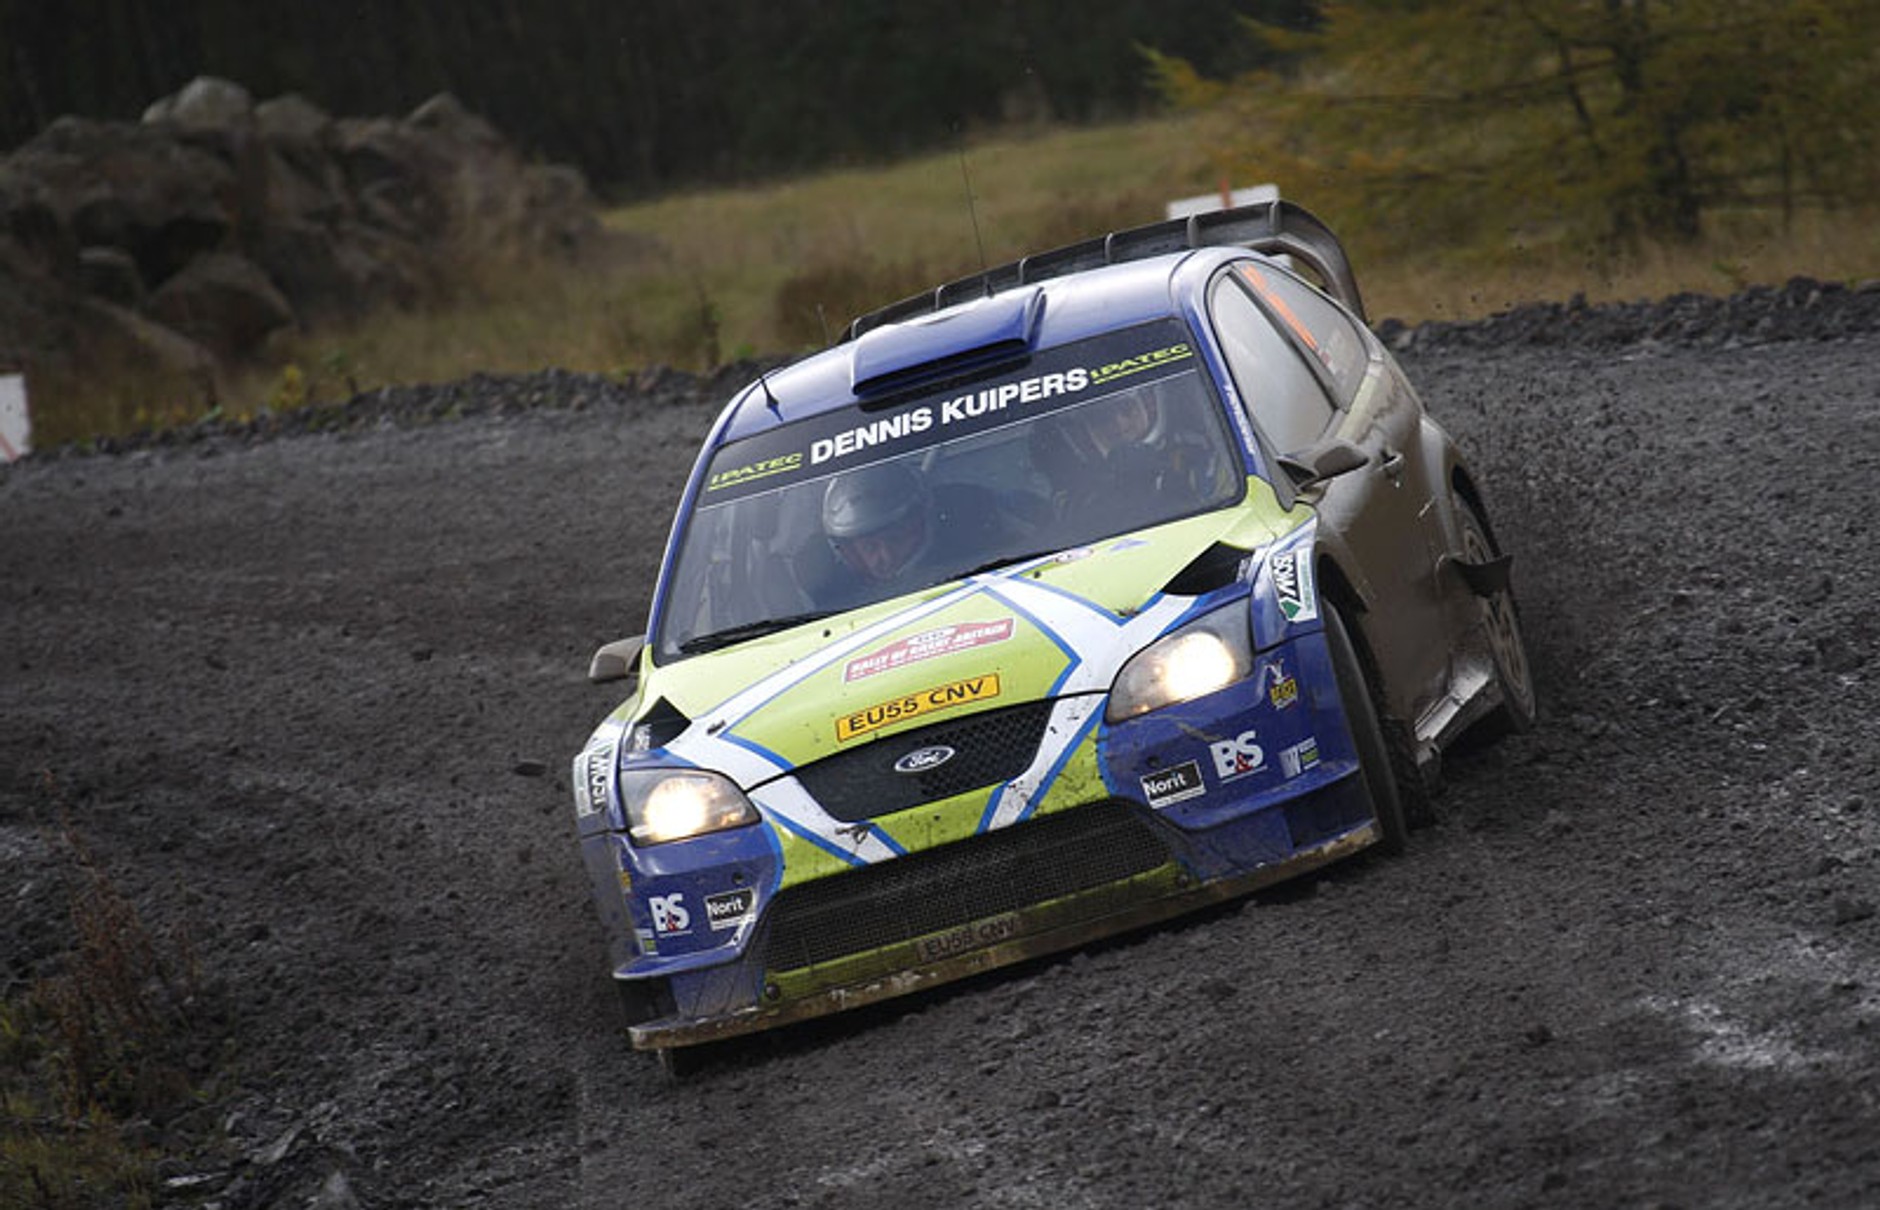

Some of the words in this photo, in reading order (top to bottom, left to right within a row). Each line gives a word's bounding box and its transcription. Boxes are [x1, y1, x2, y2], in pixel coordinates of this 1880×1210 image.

[810, 400, 933, 465] DENNIS
[940, 367, 1090, 426] KUIPERS
[848, 697, 918, 732] EU55
[928, 679, 985, 705] CNV
[906, 751, 940, 768] Ford
[1143, 773, 1187, 796] Norit
[706, 897, 744, 917] Norit
